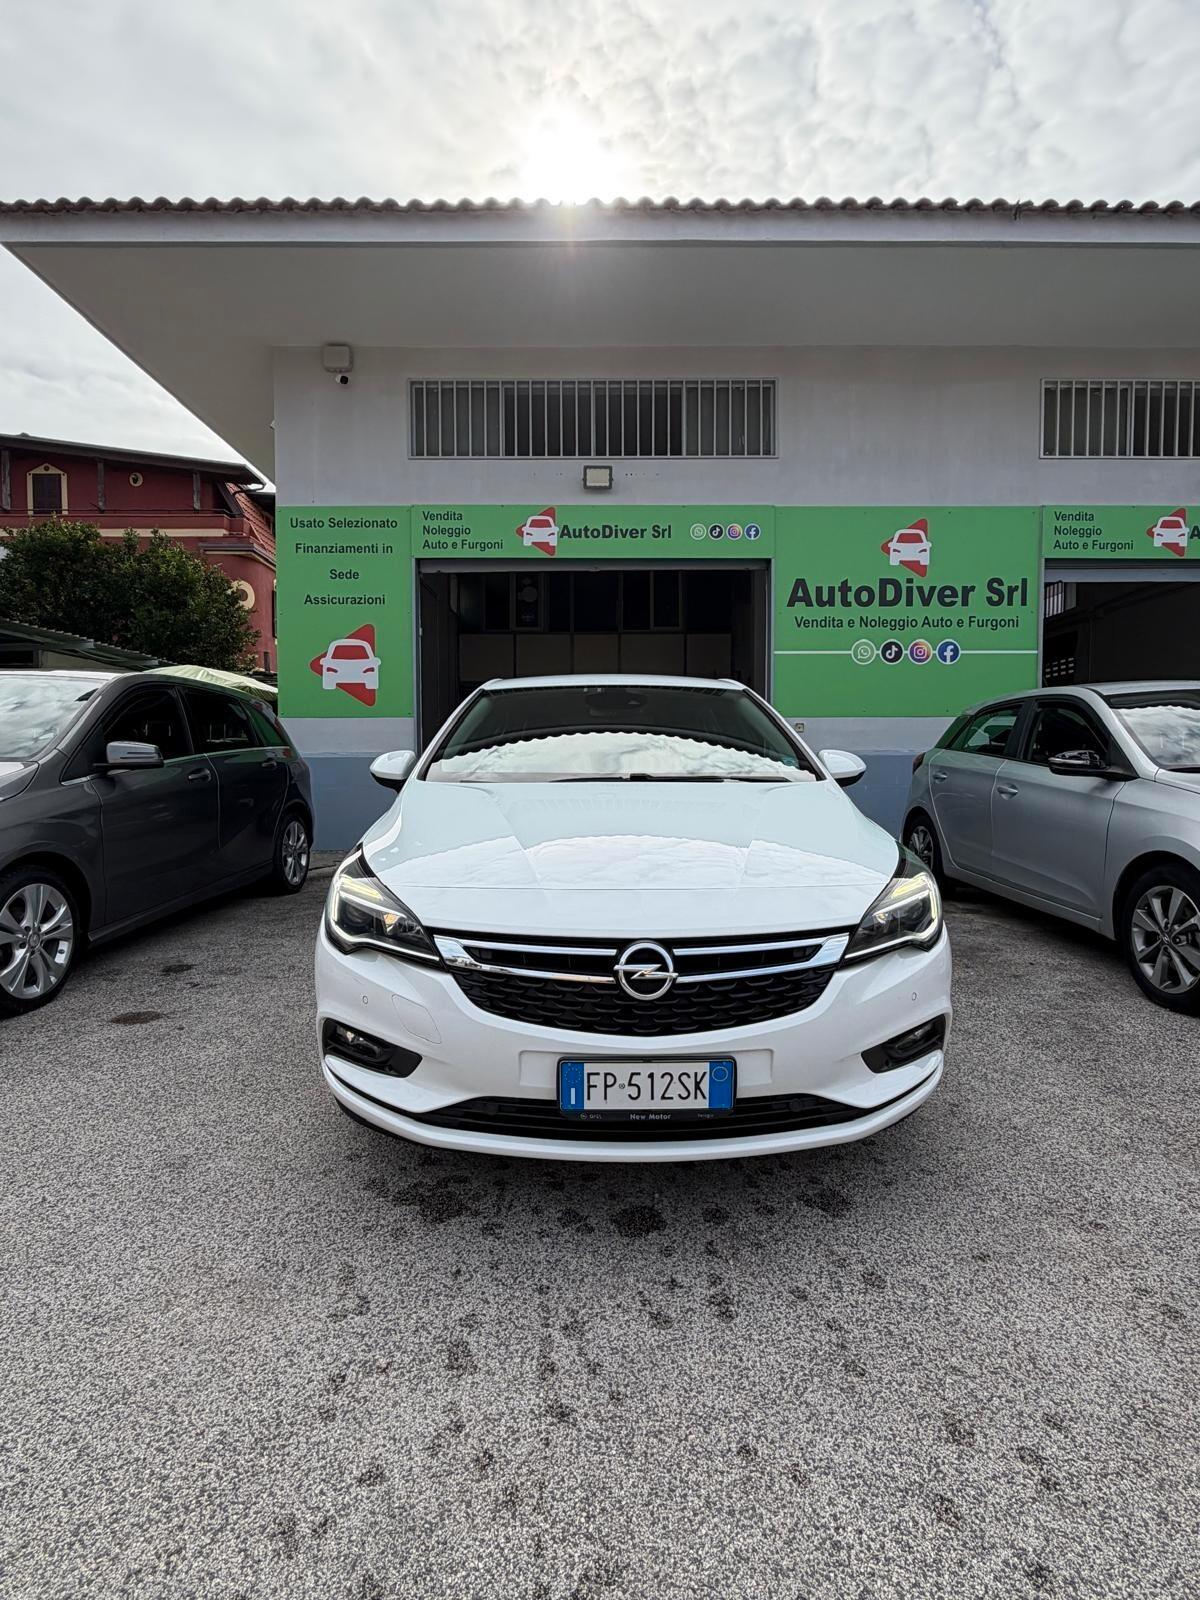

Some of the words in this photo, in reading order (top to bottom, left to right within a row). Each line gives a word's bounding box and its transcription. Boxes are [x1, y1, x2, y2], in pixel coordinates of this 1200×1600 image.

[422, 510, 463, 521] Vendita
[1054, 510, 1095, 522] Vendita
[290, 518, 325, 528] Usato
[328, 517, 398, 529] Selezionato
[422, 525, 471, 537] Noleggio
[559, 524, 647, 539] AutoDiver
[651, 524, 672, 539] Srl
[1054, 525, 1102, 538] Noleggio
[295, 543, 379, 554] Finanziamenti
[382, 543, 393, 554] in
[422, 539, 448, 550] Auto
[451, 542, 458, 550] e
[461, 539, 504, 551] Furgoni
[1053, 540, 1080, 550] Auto
[1082, 542, 1089, 550] e
[1092, 540, 1134, 552] Furgoni
[329, 569, 360, 580] Sede
[787, 578, 976, 608] AutoDiver
[985, 577, 1028, 607] Srl
[304, 594, 386, 605] Assicurazioni
[794, 616, 844, 628] Vendita
[848, 618, 855, 628] e
[860, 616, 918, 630] Noleggio
[921, 616, 953, 628] Auto
[956, 618, 964, 628] e
[968, 616, 1020, 630] Furgoni
[648, 1112, 672, 1120] Motor
